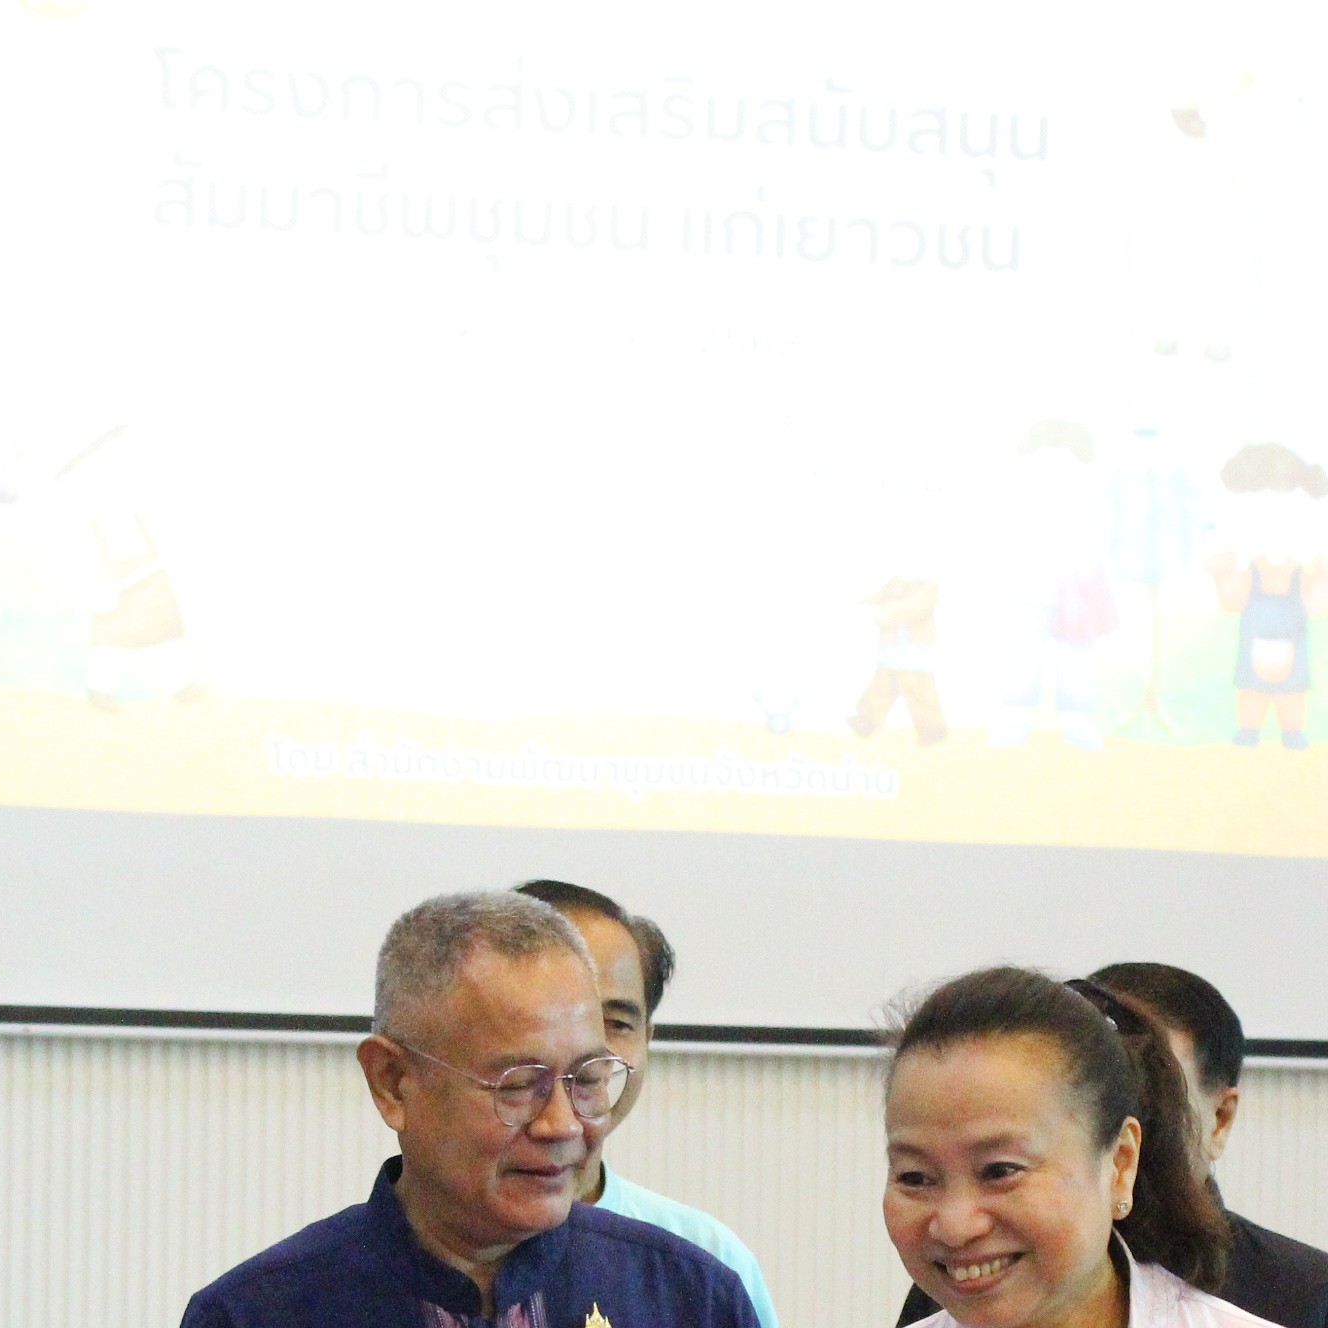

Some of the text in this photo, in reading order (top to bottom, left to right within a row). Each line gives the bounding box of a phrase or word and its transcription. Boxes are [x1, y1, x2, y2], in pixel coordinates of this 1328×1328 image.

[151, 46, 1050, 187] โครงการส่งเสริมสนับสนุน
[154, 152, 1022, 273] สัมมาชีพชุมชน แก่เยาวชน
